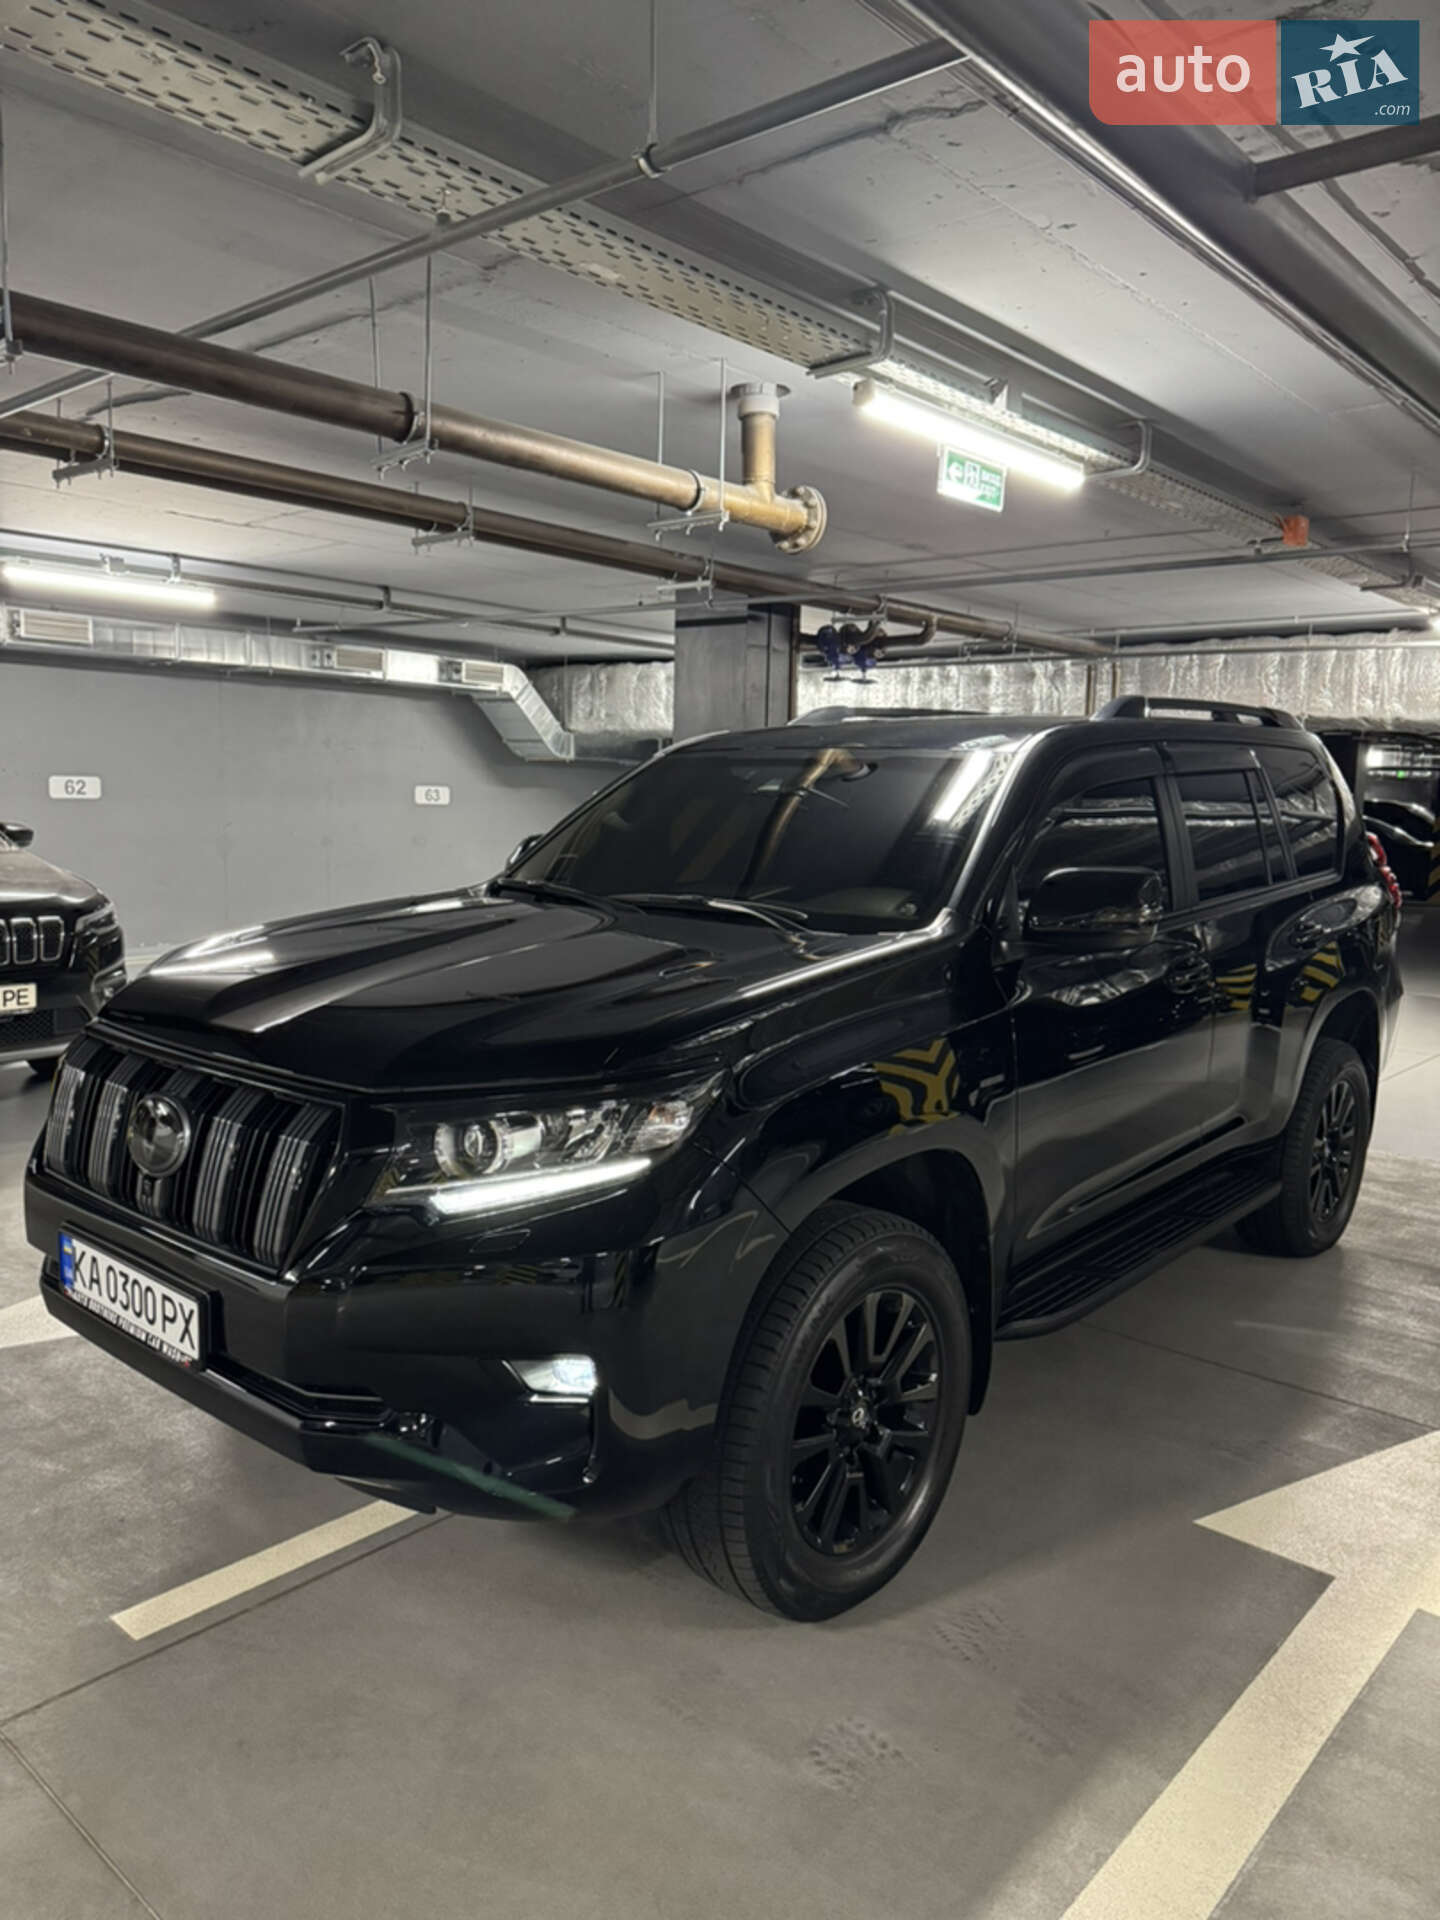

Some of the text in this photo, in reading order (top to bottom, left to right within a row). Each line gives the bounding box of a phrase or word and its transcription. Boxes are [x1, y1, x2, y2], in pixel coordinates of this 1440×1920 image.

[64, 779, 87, 796] 62
[424, 788, 440, 802] 63
[3, 988, 29, 1007] PE
